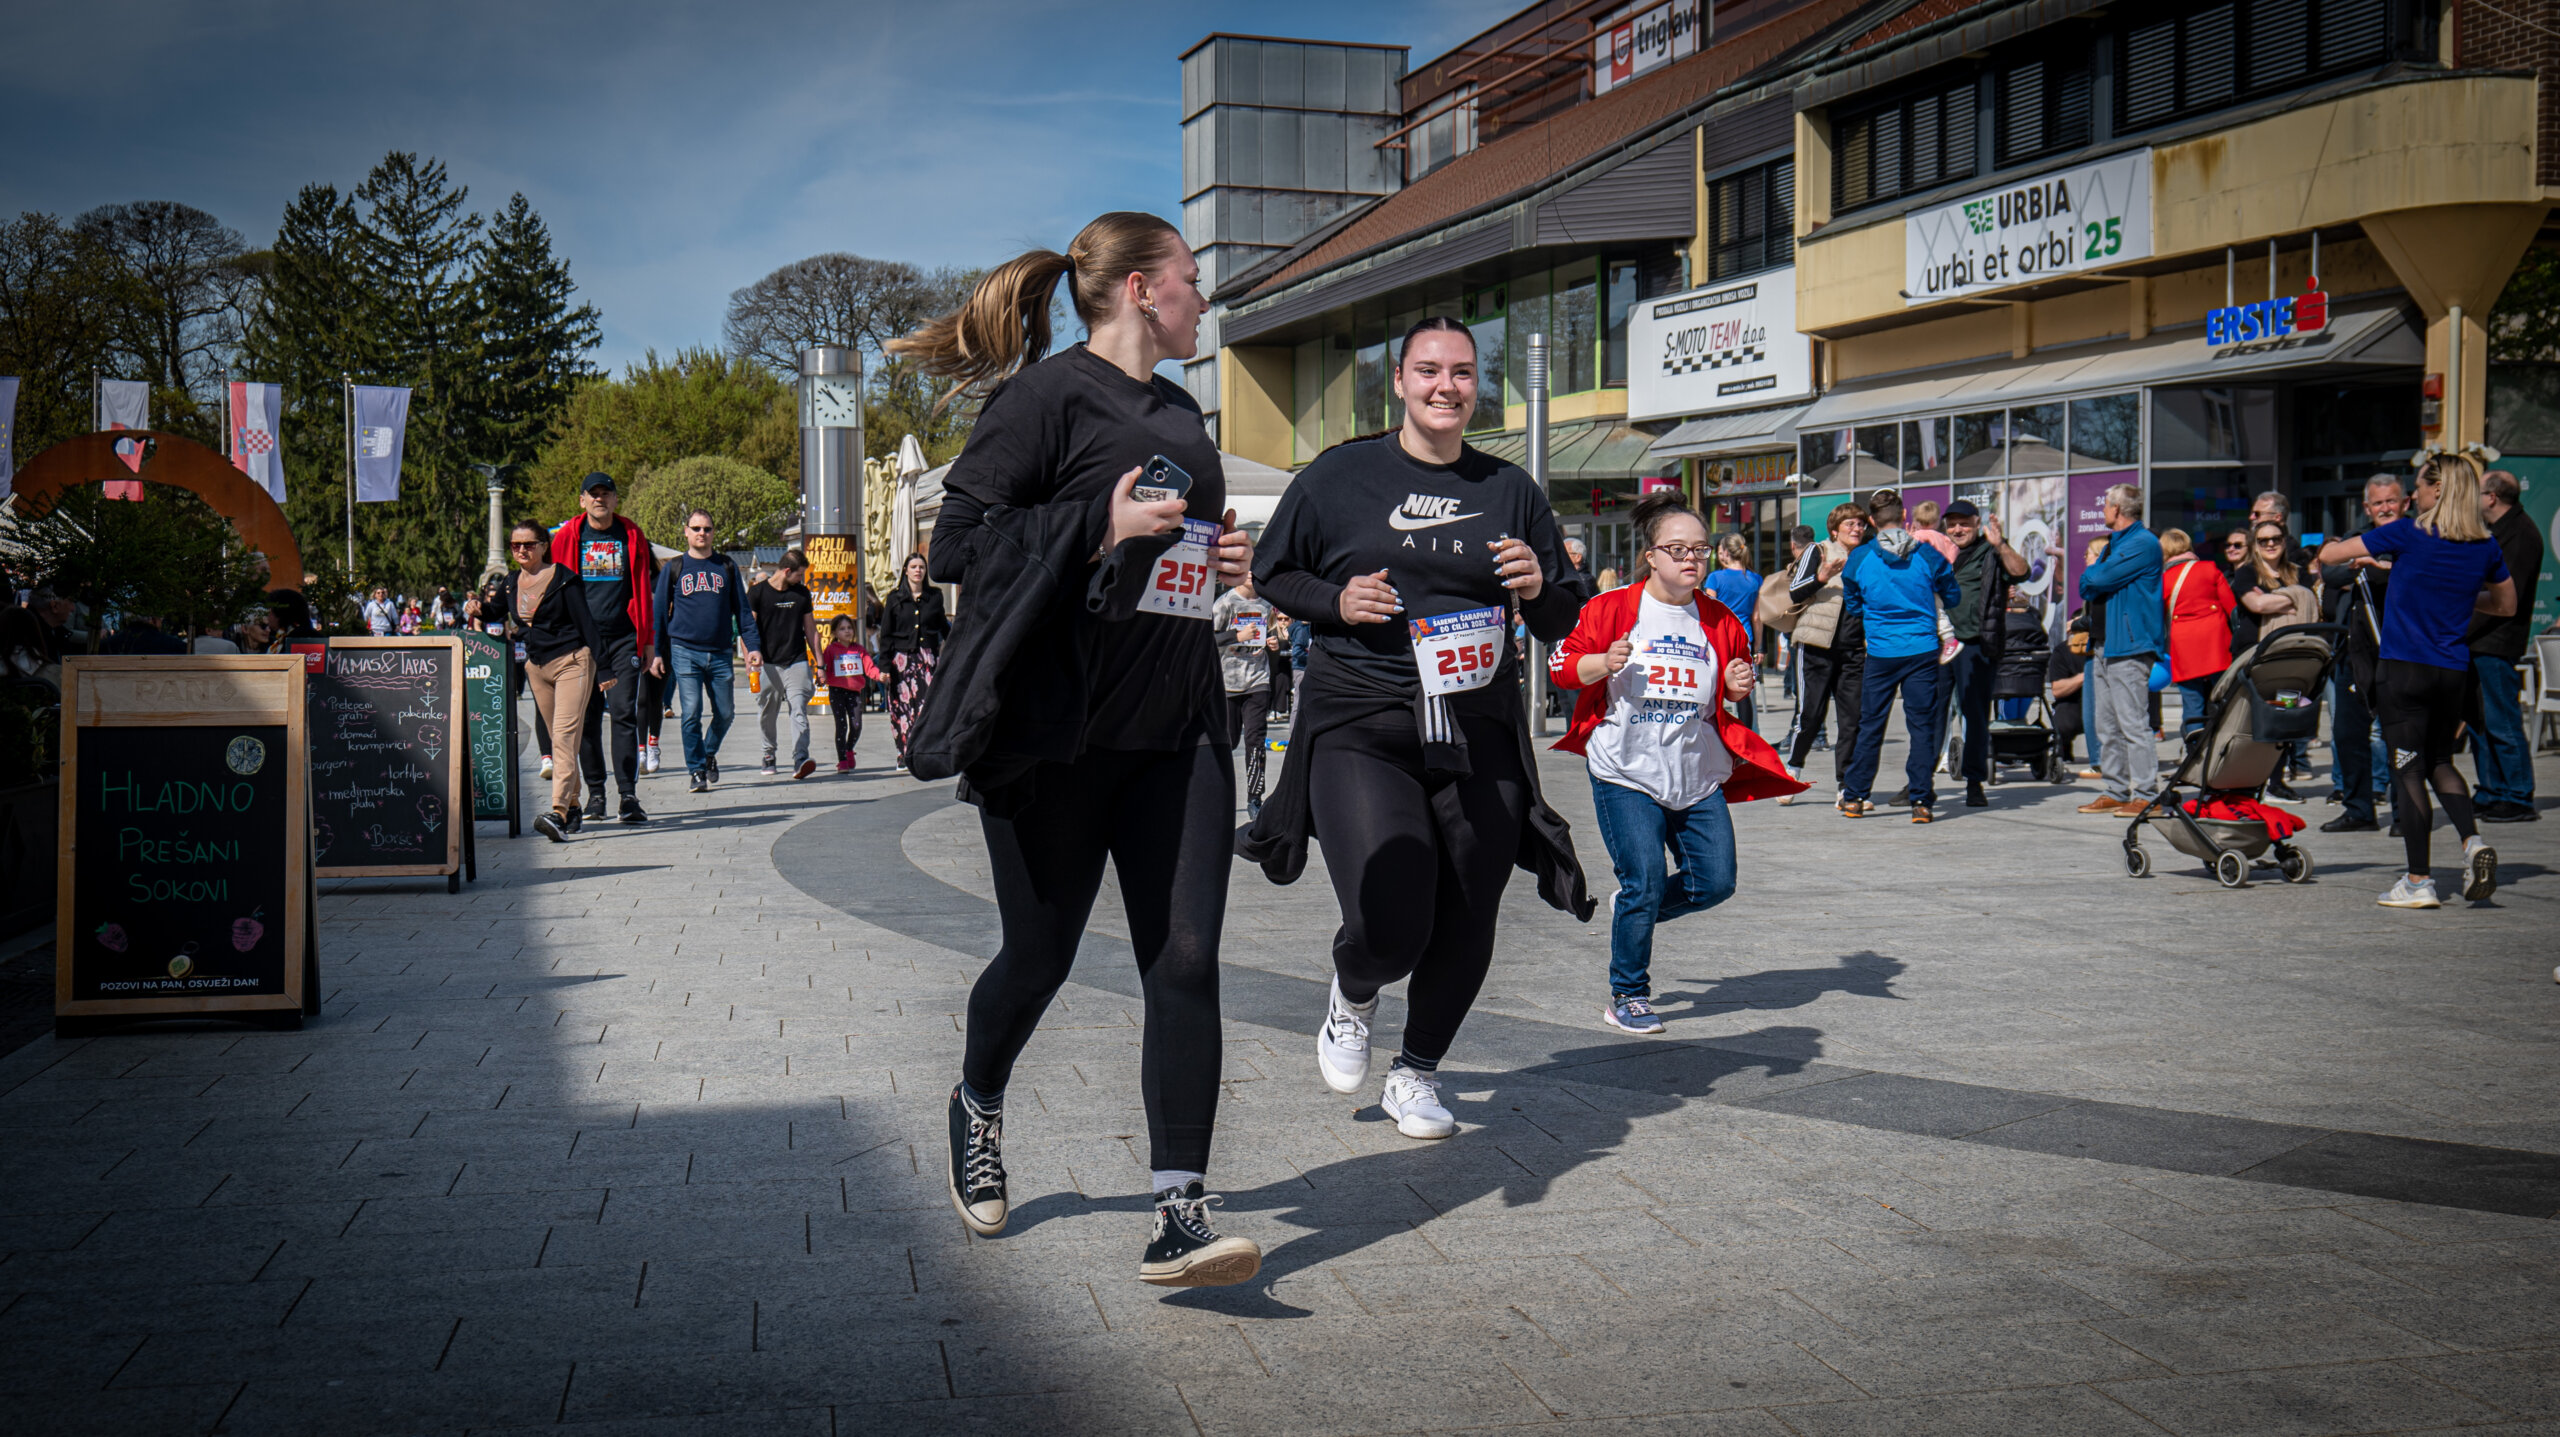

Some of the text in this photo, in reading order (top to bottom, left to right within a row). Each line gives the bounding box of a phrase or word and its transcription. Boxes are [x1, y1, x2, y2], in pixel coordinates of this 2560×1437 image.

[1637, 5, 1695, 57] triglav
[1998, 178, 2072, 229] URBIA
[1926, 216, 2122, 294] urbi et orbi 25
[1738, 286, 1755, 300] VOZILA
[2206, 296, 2293, 347] ERSTE
[1664, 318, 1767, 359] S-MOTO TEAM d.o.o.
[1735, 455, 1787, 485] BASHA
[1402, 493, 1461, 520] NIKE
[2080, 510, 2098, 520] Erste
[591, 541, 615, 553] NIKE
[814, 537, 846, 552] POLU
[1402, 533, 1463, 555] AIR
[805, 550, 857, 566] MARATON
[681, 571, 725, 596] GAP
[1156, 559, 1208, 596] 257
[1439, 626, 1450, 634] DO
[1451, 622, 1470, 631] CILJA
[839, 662, 860, 671] 501
[1435, 642, 1495, 676] 256
[1648, 665, 1698, 689] 211
[135, 680, 211, 703] PAN
[1642, 699, 1663, 709] AN
[1667, 700, 1703, 712] EXTR
[102, 770, 254, 815] HLADNO
[119, 827, 239, 864] PREŠANI
[128, 873, 229, 903] SOKOVI
[100, 977, 259, 991] POZOVI NA PAN, OSVJEŽI DAN!
